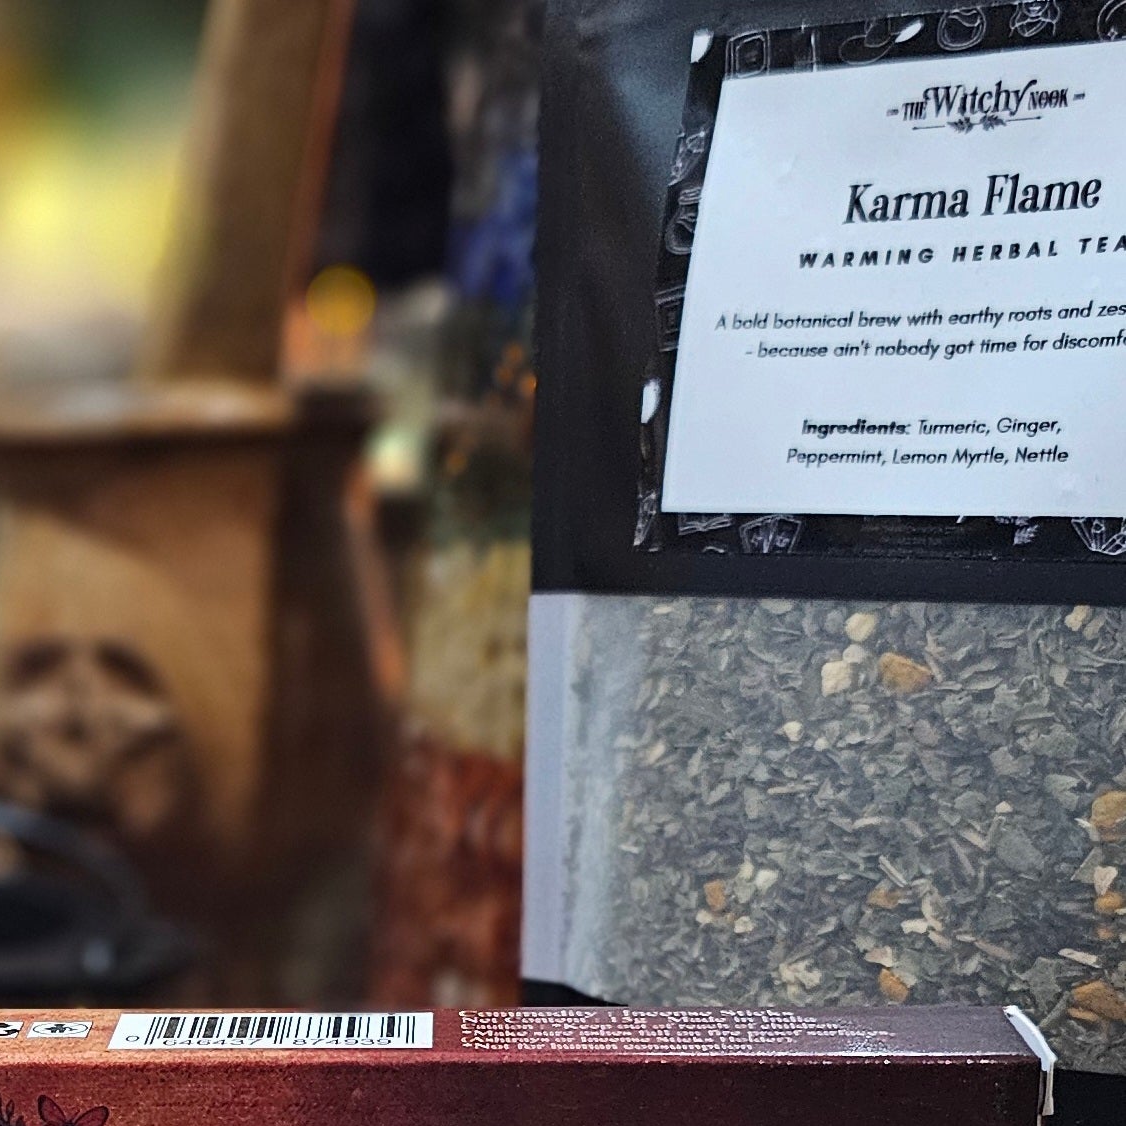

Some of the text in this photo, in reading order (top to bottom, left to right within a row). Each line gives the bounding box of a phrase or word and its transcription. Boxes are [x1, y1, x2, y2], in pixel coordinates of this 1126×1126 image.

[902, 79, 1069, 121] THE Witchy NOOK
[842, 173, 1102, 224] Karma Flame
[799, 235, 1126, 269] WARMING HERBAL TEA
[715, 314, 727, 331] A
[732, 312, 769, 330] bold
[773, 311, 854, 329] botanical
[858, 311, 902, 328] brew
[907, 308, 943, 326] with
[948, 306, 1004, 328] earthy
[1008, 306, 1052, 322] roots
[1057, 300, 1093, 319] and
[757, 341, 828, 358] because
[833, 340, 871, 357] ain't
[874, 339, 940, 360] nobody
[943, 340, 975, 360] got
[980, 339, 1017, 354] time
[1023, 334, 1048, 351] for
[1052, 329, 1126, 350] discomf
[801, 417, 1062, 439] Ingredients: Turmeric, Ginger,
[786, 444, 1069, 469] Peppermint, Lemon Myrtle, Nettle
